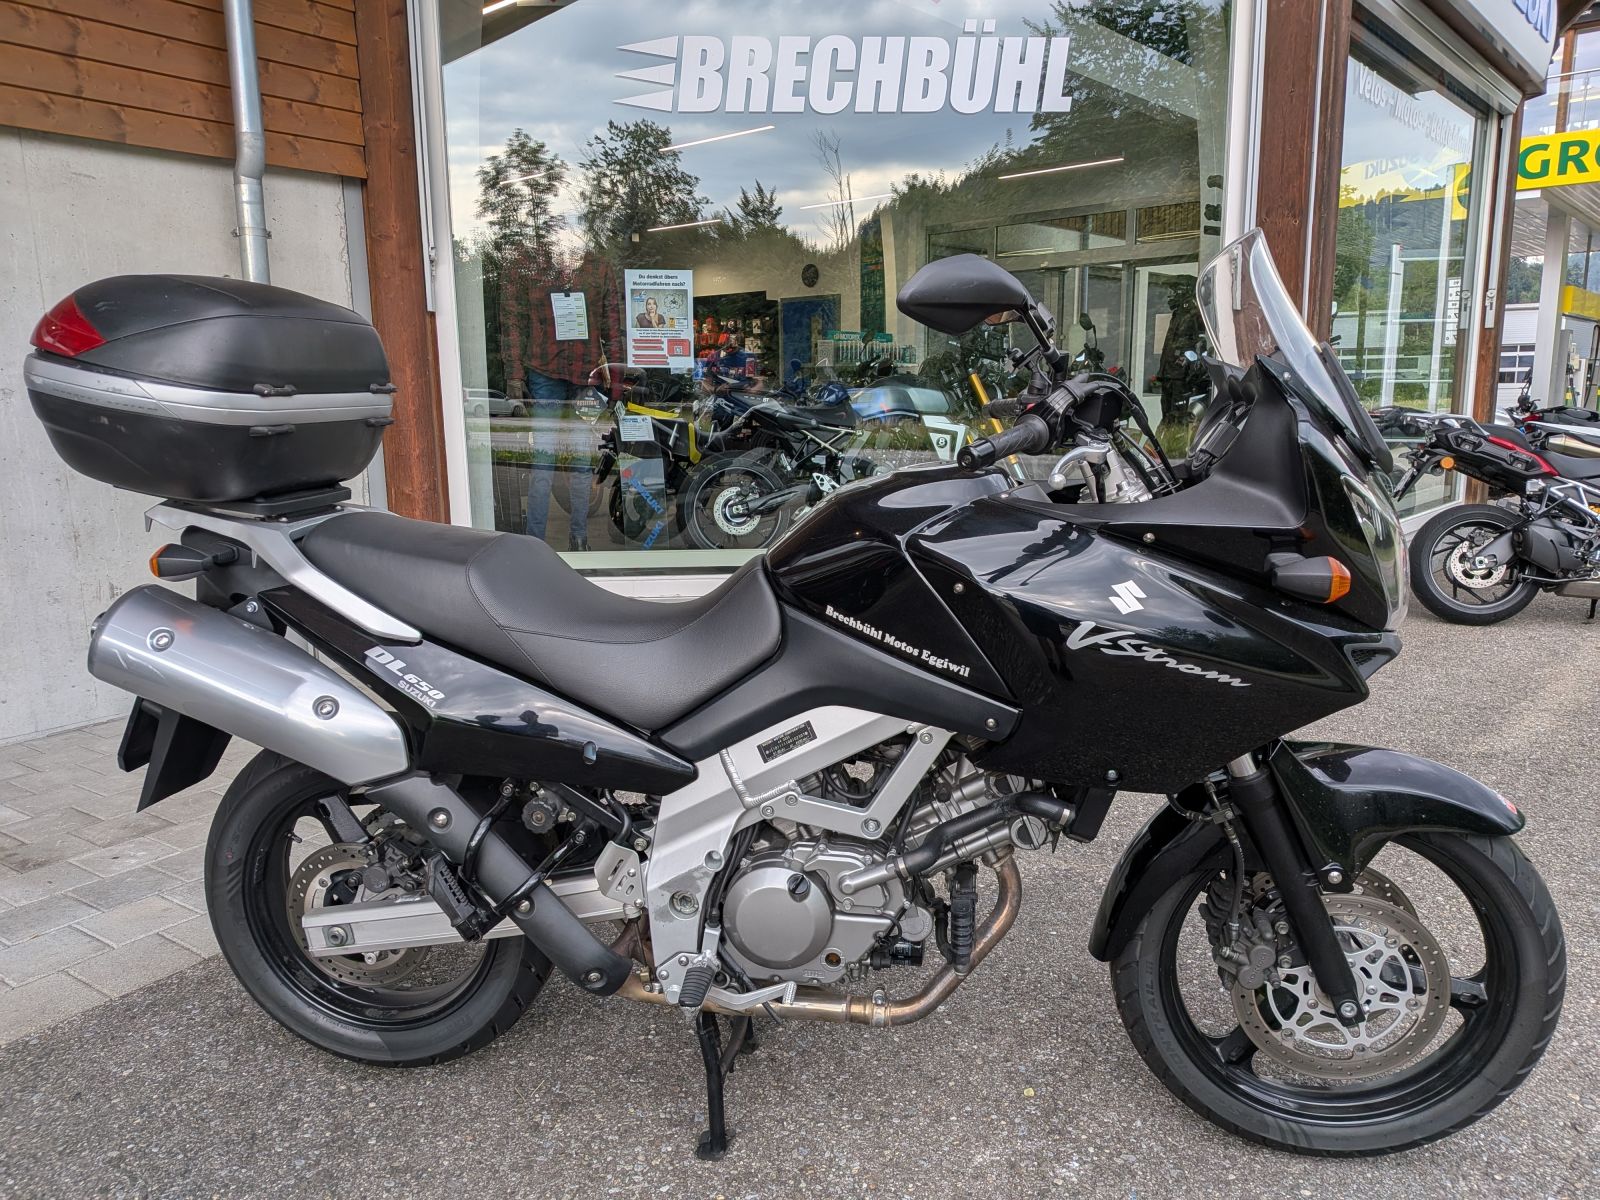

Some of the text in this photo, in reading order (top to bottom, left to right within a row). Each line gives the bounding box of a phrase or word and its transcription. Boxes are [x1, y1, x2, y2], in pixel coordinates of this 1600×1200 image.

[677, 18, 1073, 114] BRECHBÜHL
[1359, 62, 1386, 108] Velos
[1518, 140, 1600, 179] GR
[825, 604, 971, 677] Brechbühl Motos Eggiwil
[397, 680, 438, 708] SUZUKI
